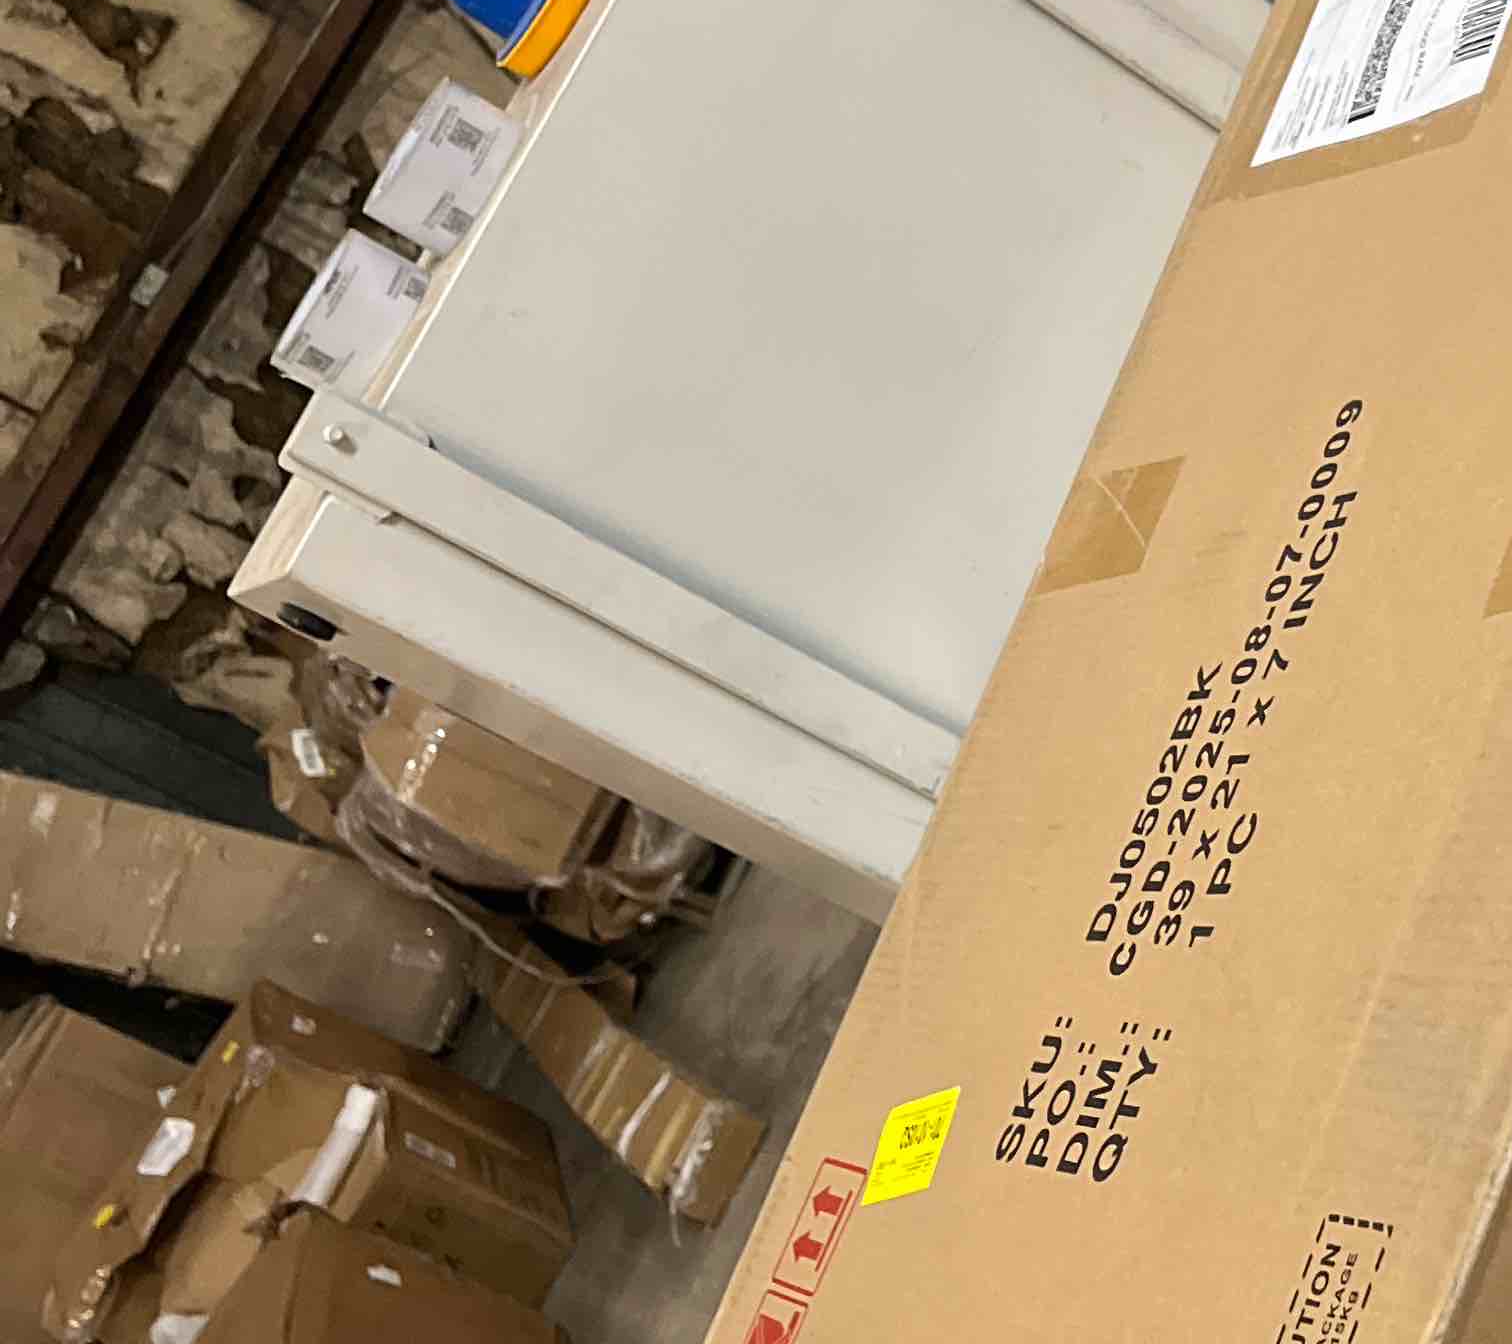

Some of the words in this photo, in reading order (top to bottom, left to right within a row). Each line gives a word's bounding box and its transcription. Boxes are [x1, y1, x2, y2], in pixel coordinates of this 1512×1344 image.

[995, 1016, 1073, 1163] SKU:
[1086, 662, 1223, 943] DJ0502BK
[1109, 399, 1363, 976] CGD-2025-08-07-0009
[1153, 879, 1196, 946] 39
[1210, 753, 1251, 810] 21
[1261, 648, 1289, 680] 7
[1282, 491, 1358, 630] INCH
[1092, 1028, 1172, 1183] QTY:
[1188, 925, 1215, 948] 1
[1205, 812, 1258, 895] PC
